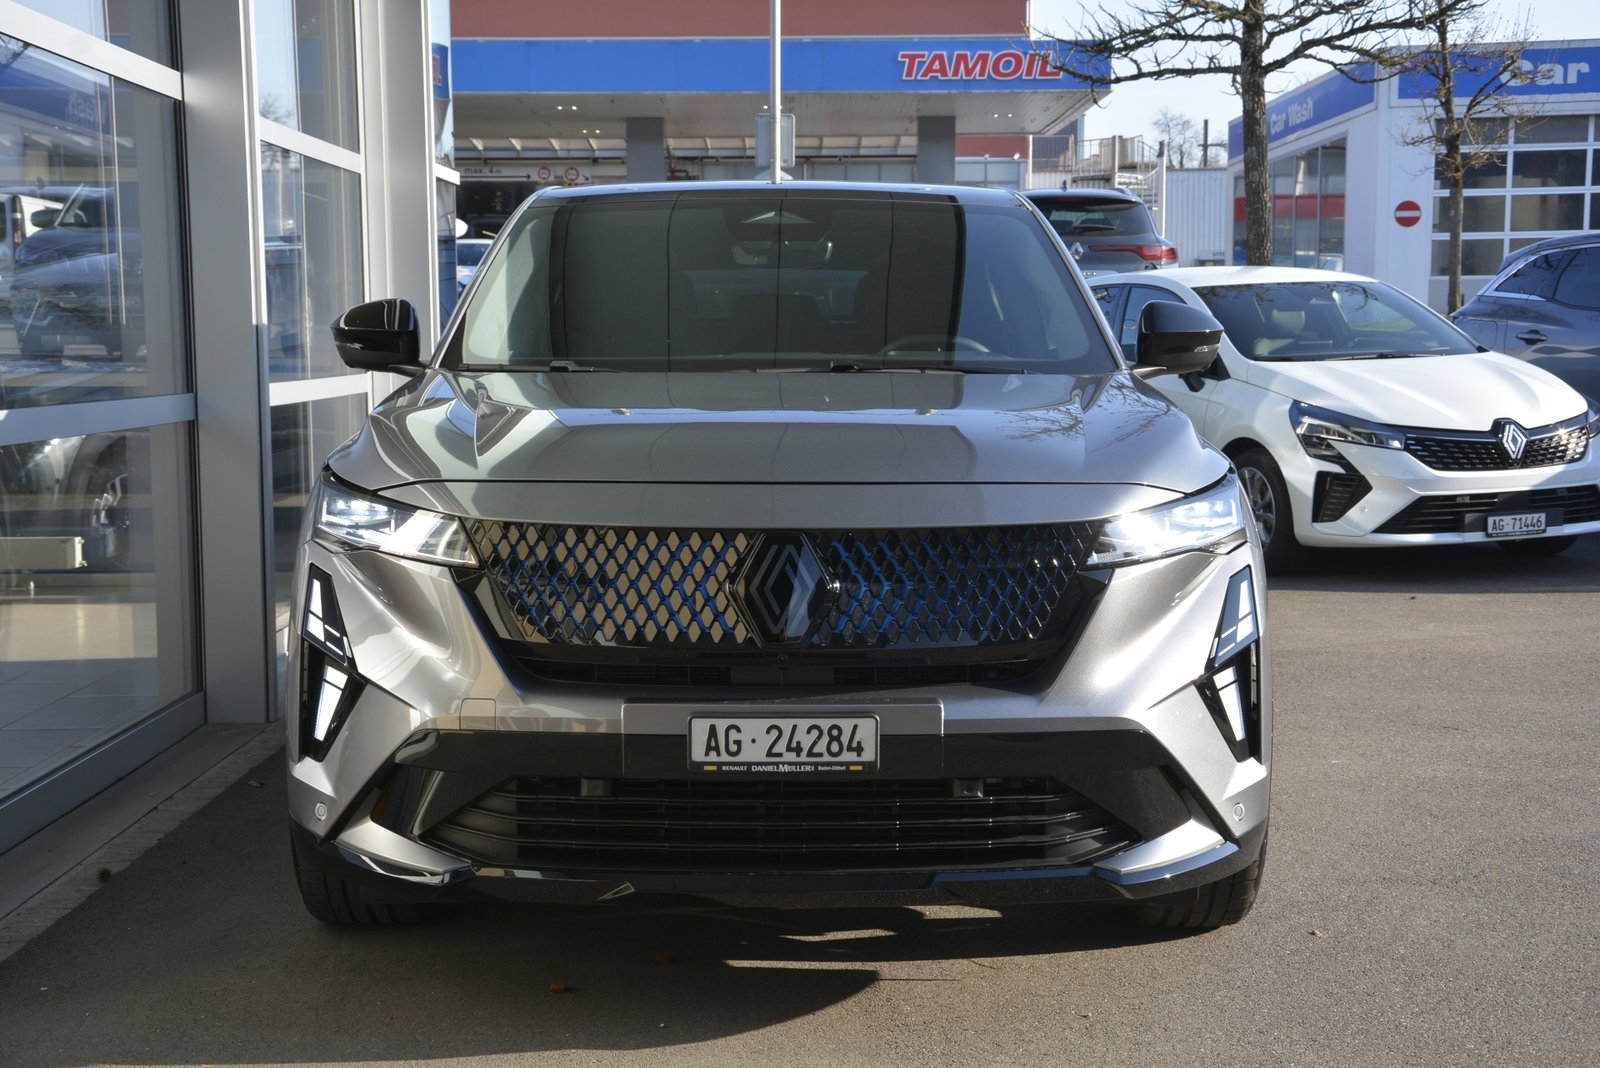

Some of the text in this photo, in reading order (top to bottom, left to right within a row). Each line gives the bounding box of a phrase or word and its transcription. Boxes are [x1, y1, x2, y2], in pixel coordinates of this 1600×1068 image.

[898, 50, 1063, 80] TAMOIL
[1499, 58, 1590, 87] Car
[1270, 97, 1313, 135] Car Wash
[464, 167, 486, 175] max.
